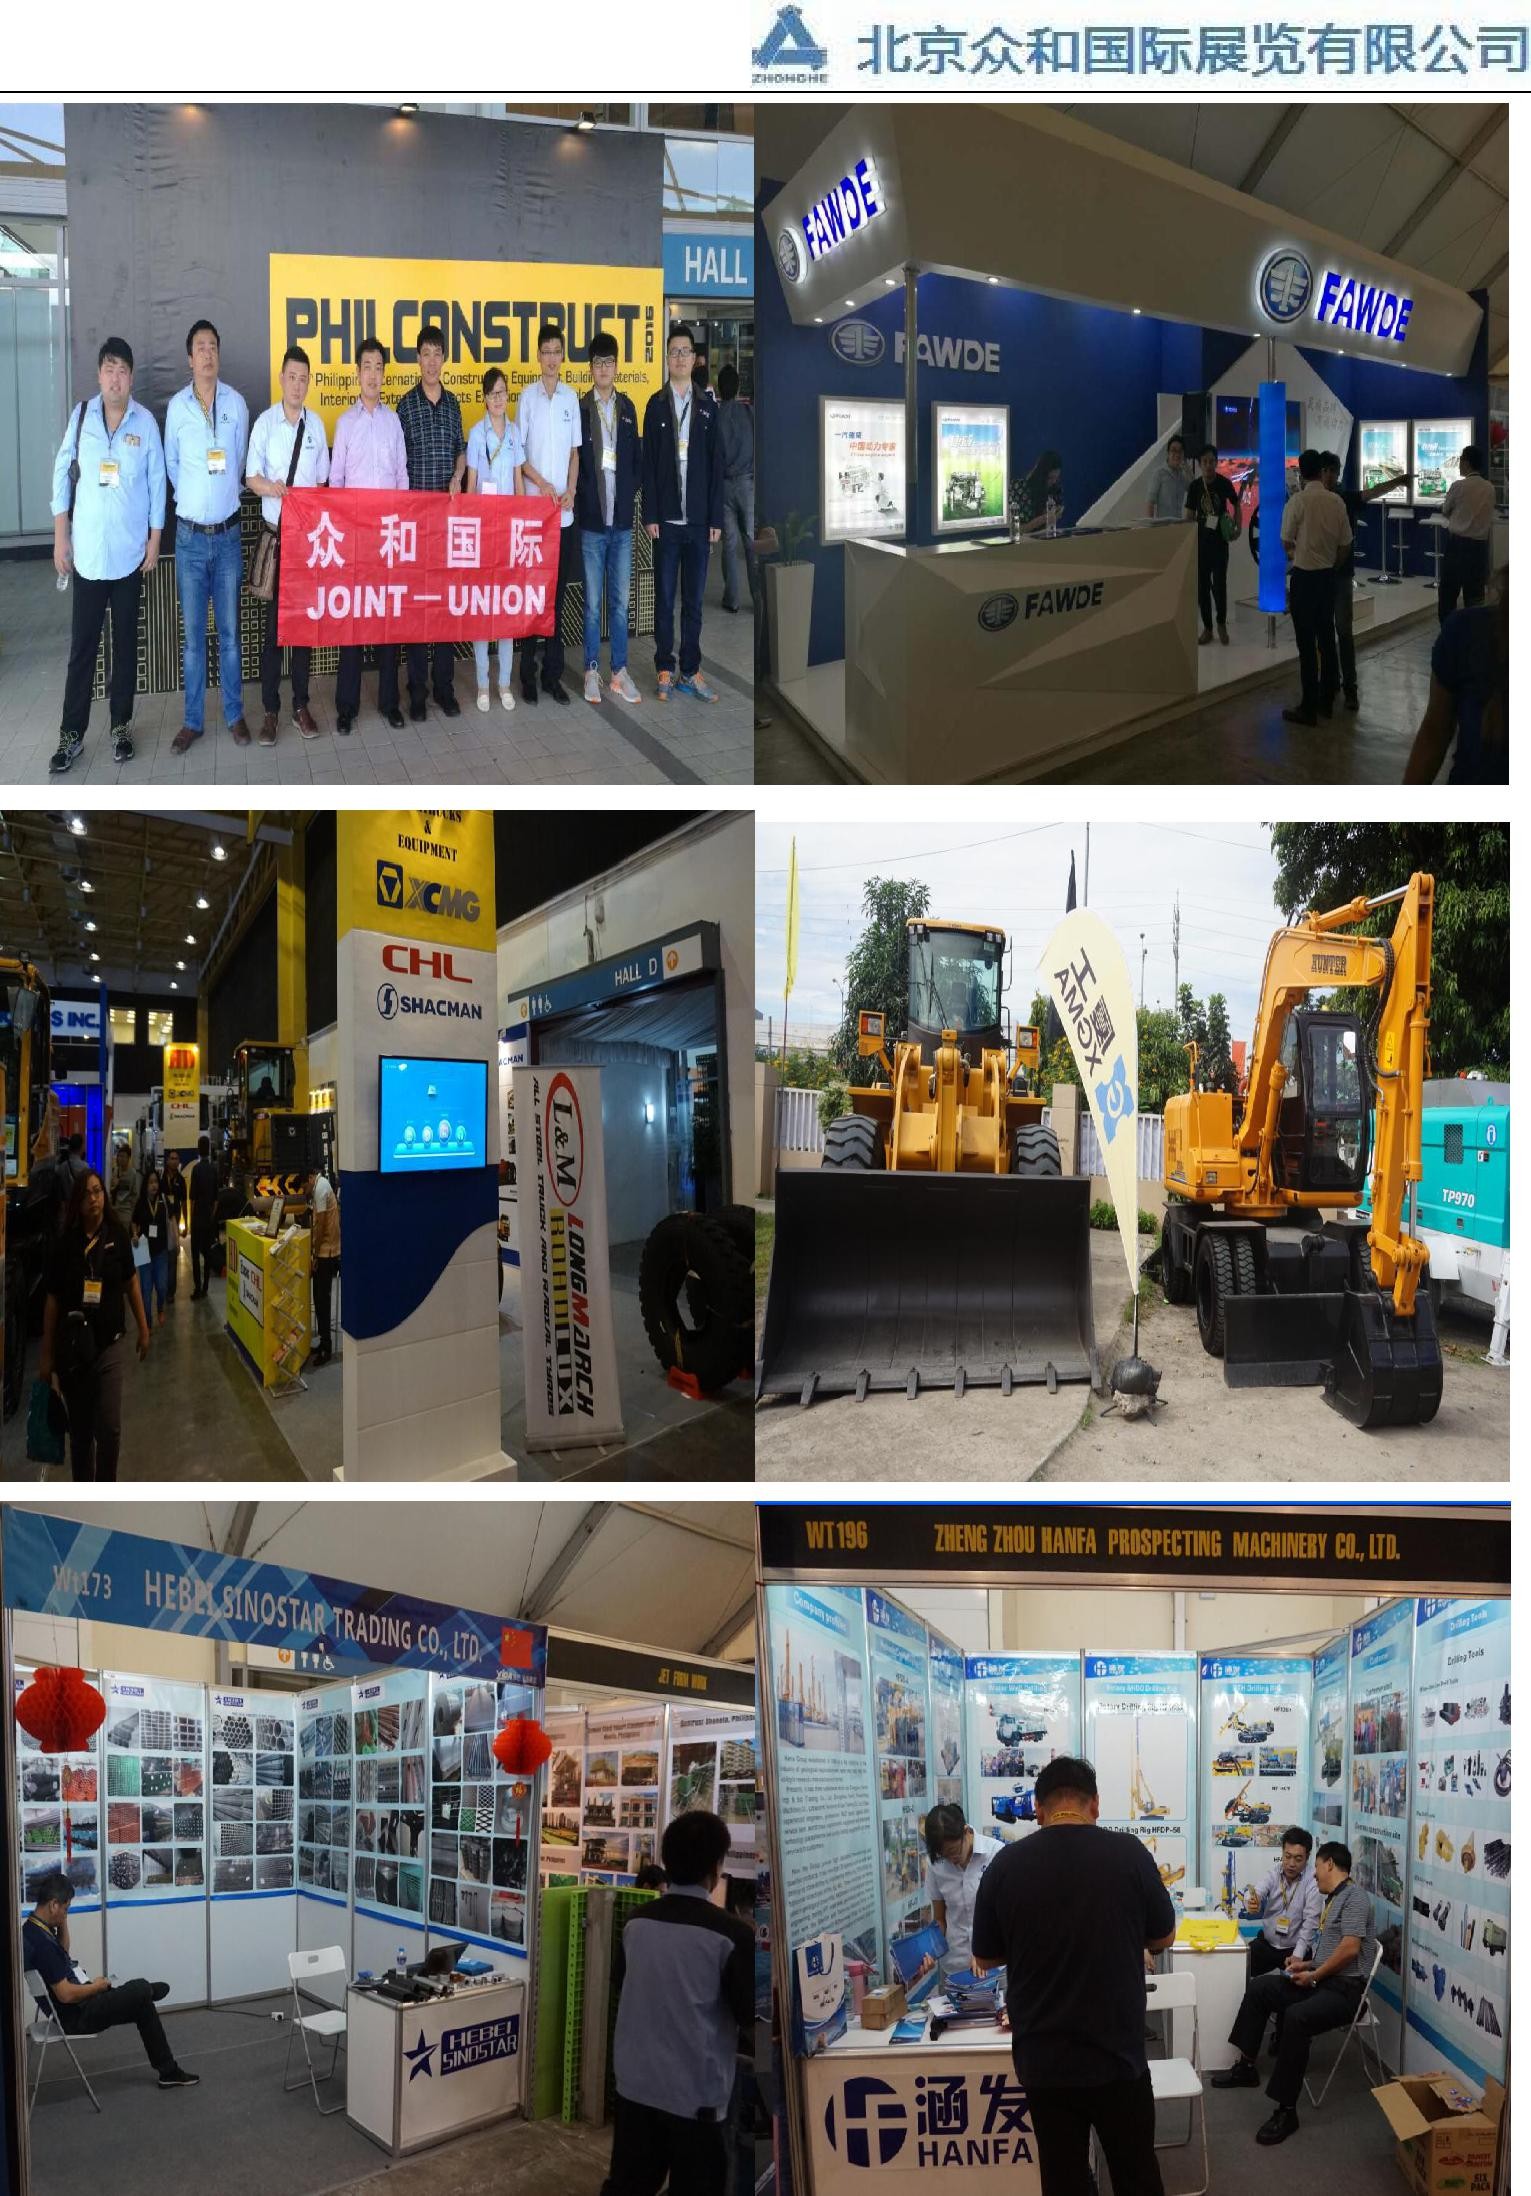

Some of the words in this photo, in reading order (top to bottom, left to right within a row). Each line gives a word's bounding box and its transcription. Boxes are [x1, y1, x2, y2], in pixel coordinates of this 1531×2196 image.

[802, 157, 883, 261] FAWDE
[685, 245, 748, 284] HALL
[1314, 270, 1414, 342] FAWDE
[894, 331, 1000, 373] FAWDE
[612, 371, 650, 385] aterials,
[306, 511, 543, 568] 众和国际
[1025, 587, 1104, 620] FAWDE
[424, 819, 431, 835] &
[398, 833, 457, 862] EQUIPMENT
[404, 877, 480, 922] XCMG
[382, 944, 473, 984] CHL
[615, 963, 642, 986] HALL
[649, 957, 658, 976] D
[67, 1011, 100, 1028] INC.
[400, 995, 482, 1019] SHACMAN
[553, 1099, 577, 1190] L&M
[537, 1174, 547, 1232] TRUCK
[1442, 1188, 1475, 1208] TP970
[540, 1236, 548, 1274] AND
[805, 1521, 868, 1549] WT196
[934, 1524, 987, 1552] ZHENG
[993, 1525, 1035, 1553] ZHOU
[1041, 1527, 1096, 1554] HANFA
[1108, 1529, 1221, 1557] PROSPECTING
[1233, 1531, 1328, 1559] MACHINERY
[1336, 1533, 1364, 1562] CO.,
[1370, 1534, 1400, 1560] LTD.
[145, 1570, 216, 1616] HEBEI
[223, 1585, 326, 1635] SINOSTAR
[333, 1607, 411, 1650] TRADING
[418, 1624, 448, 1661] CO.,
[454, 1631, 482, 1663] LTD.
[658, 1668, 670, 1684] JET
[443, 2034, 517, 2070] SINOSTAR
[449, 2021, 512, 2050] HEBEI
[915, 2074, 1034, 2135] 涵发
[918, 2138, 1034, 2167] HANFA
